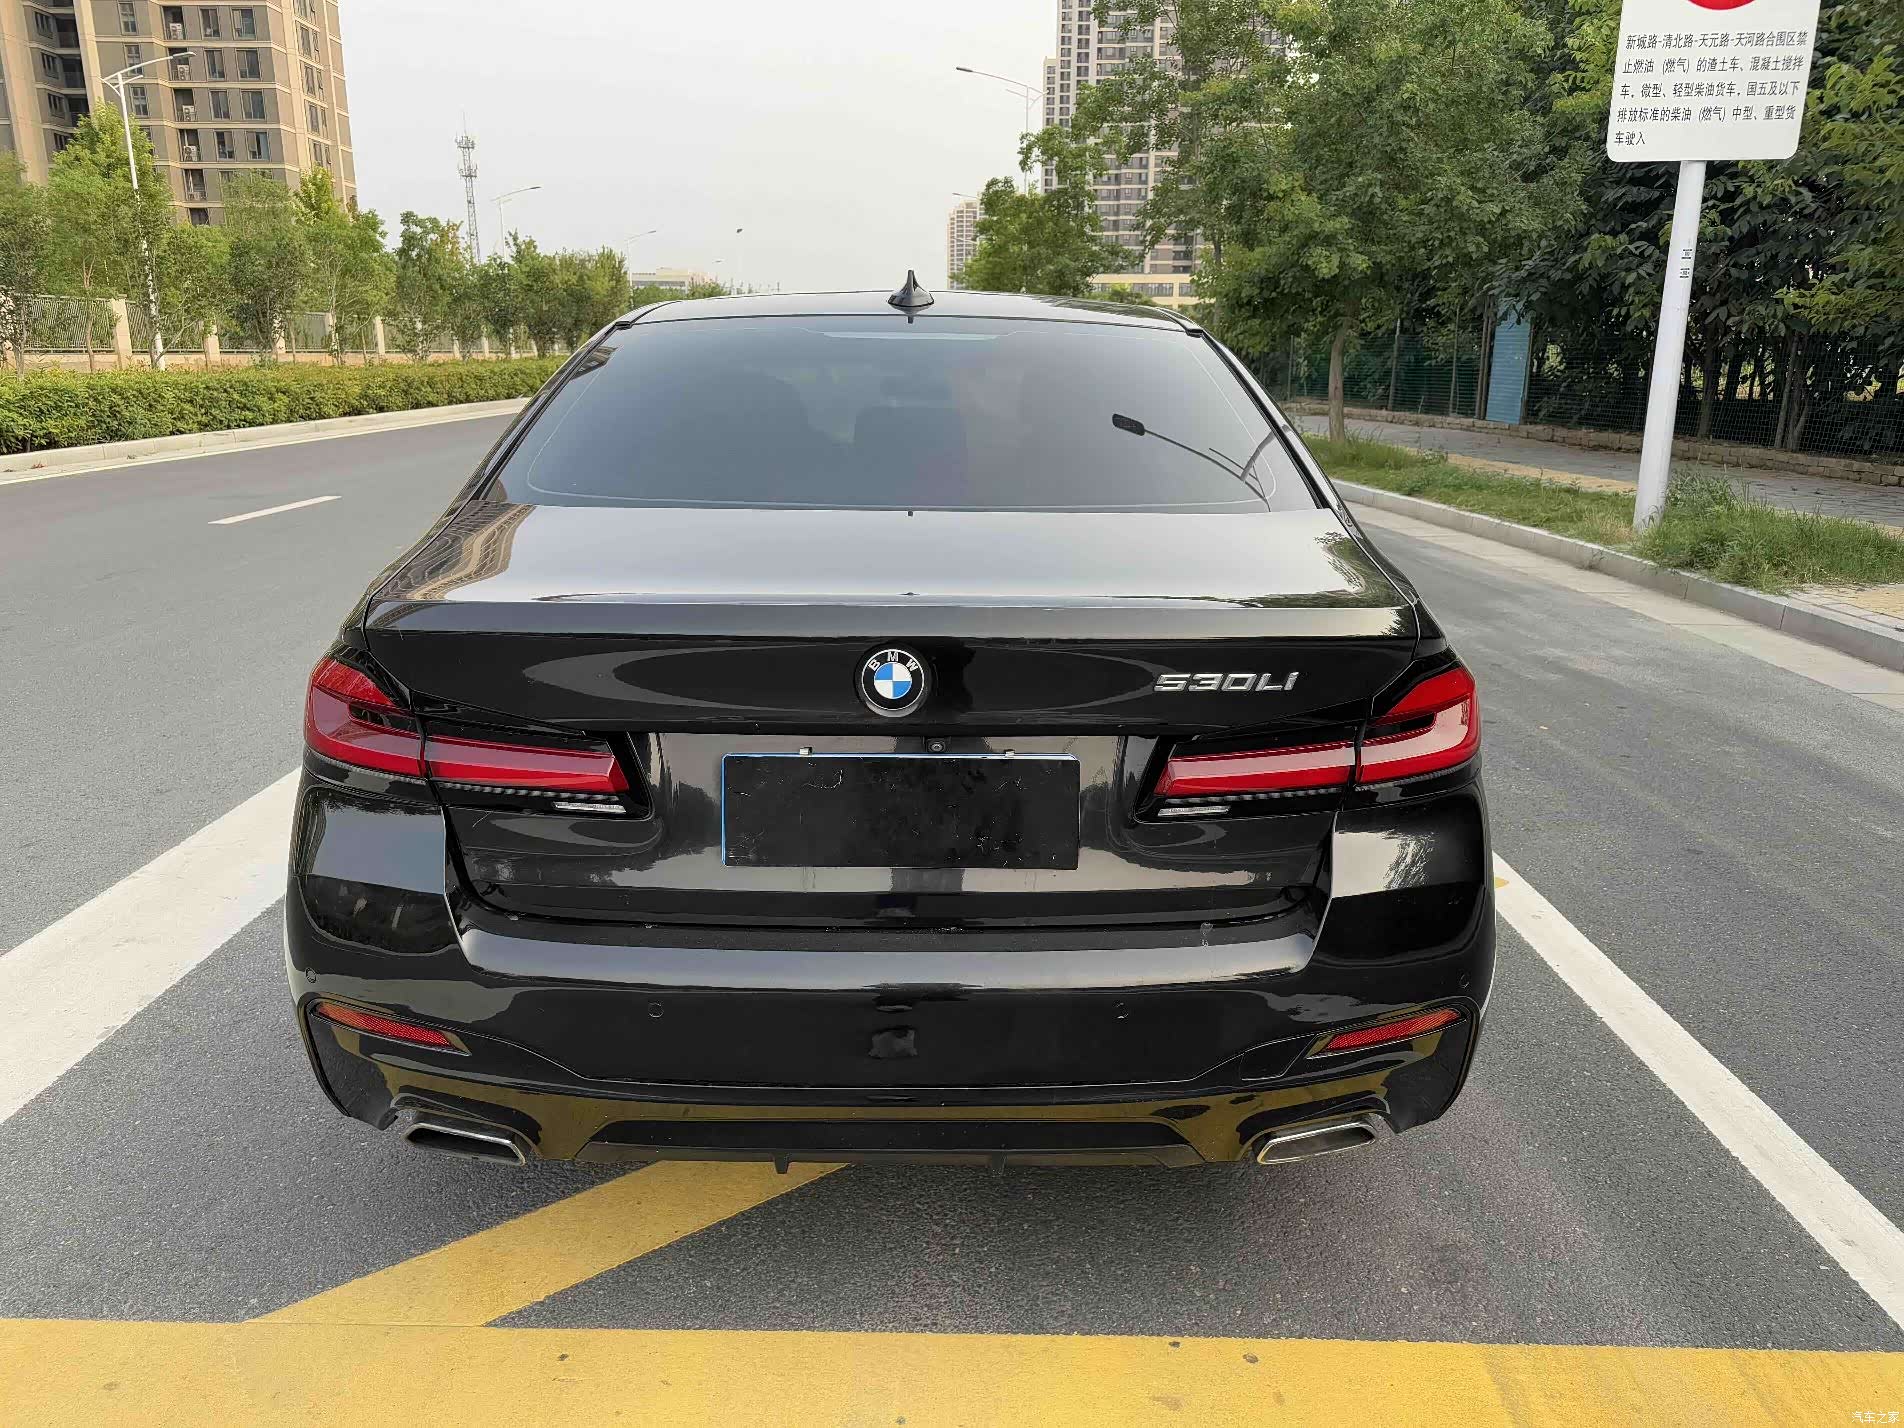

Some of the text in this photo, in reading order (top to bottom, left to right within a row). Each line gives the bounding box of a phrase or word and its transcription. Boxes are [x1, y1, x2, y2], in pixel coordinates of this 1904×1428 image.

[1614, 130, 1646, 146] 车驶入
[868, 650, 920, 672] BMW
[1153, 671, 1300, 693] 530Li
